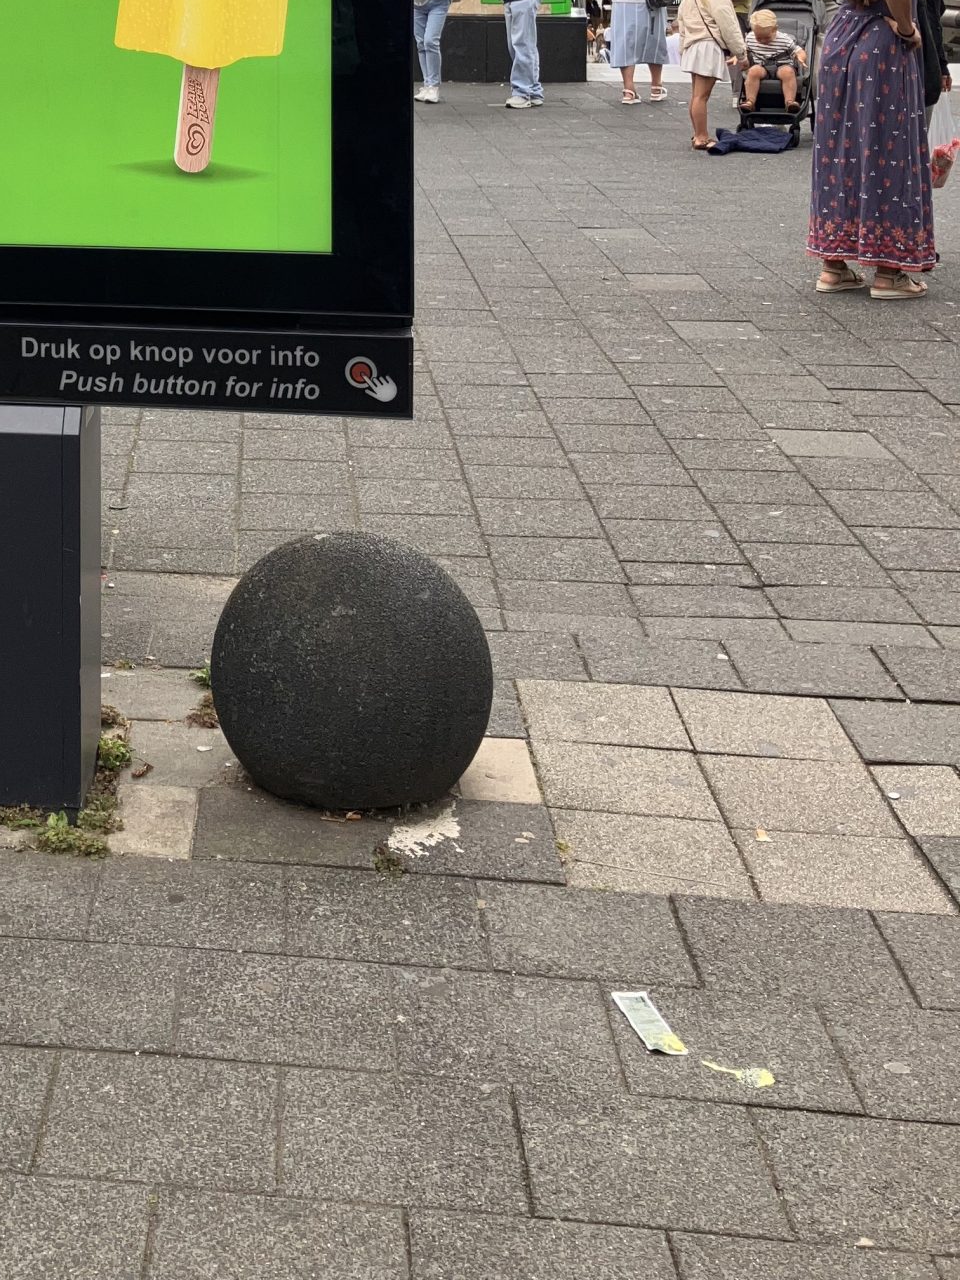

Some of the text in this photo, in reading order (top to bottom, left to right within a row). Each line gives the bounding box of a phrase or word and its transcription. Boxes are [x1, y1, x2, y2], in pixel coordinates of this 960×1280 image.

[21, 336, 321, 368] Druk op knop voor info
[59, 370, 321, 400] Push button for info
